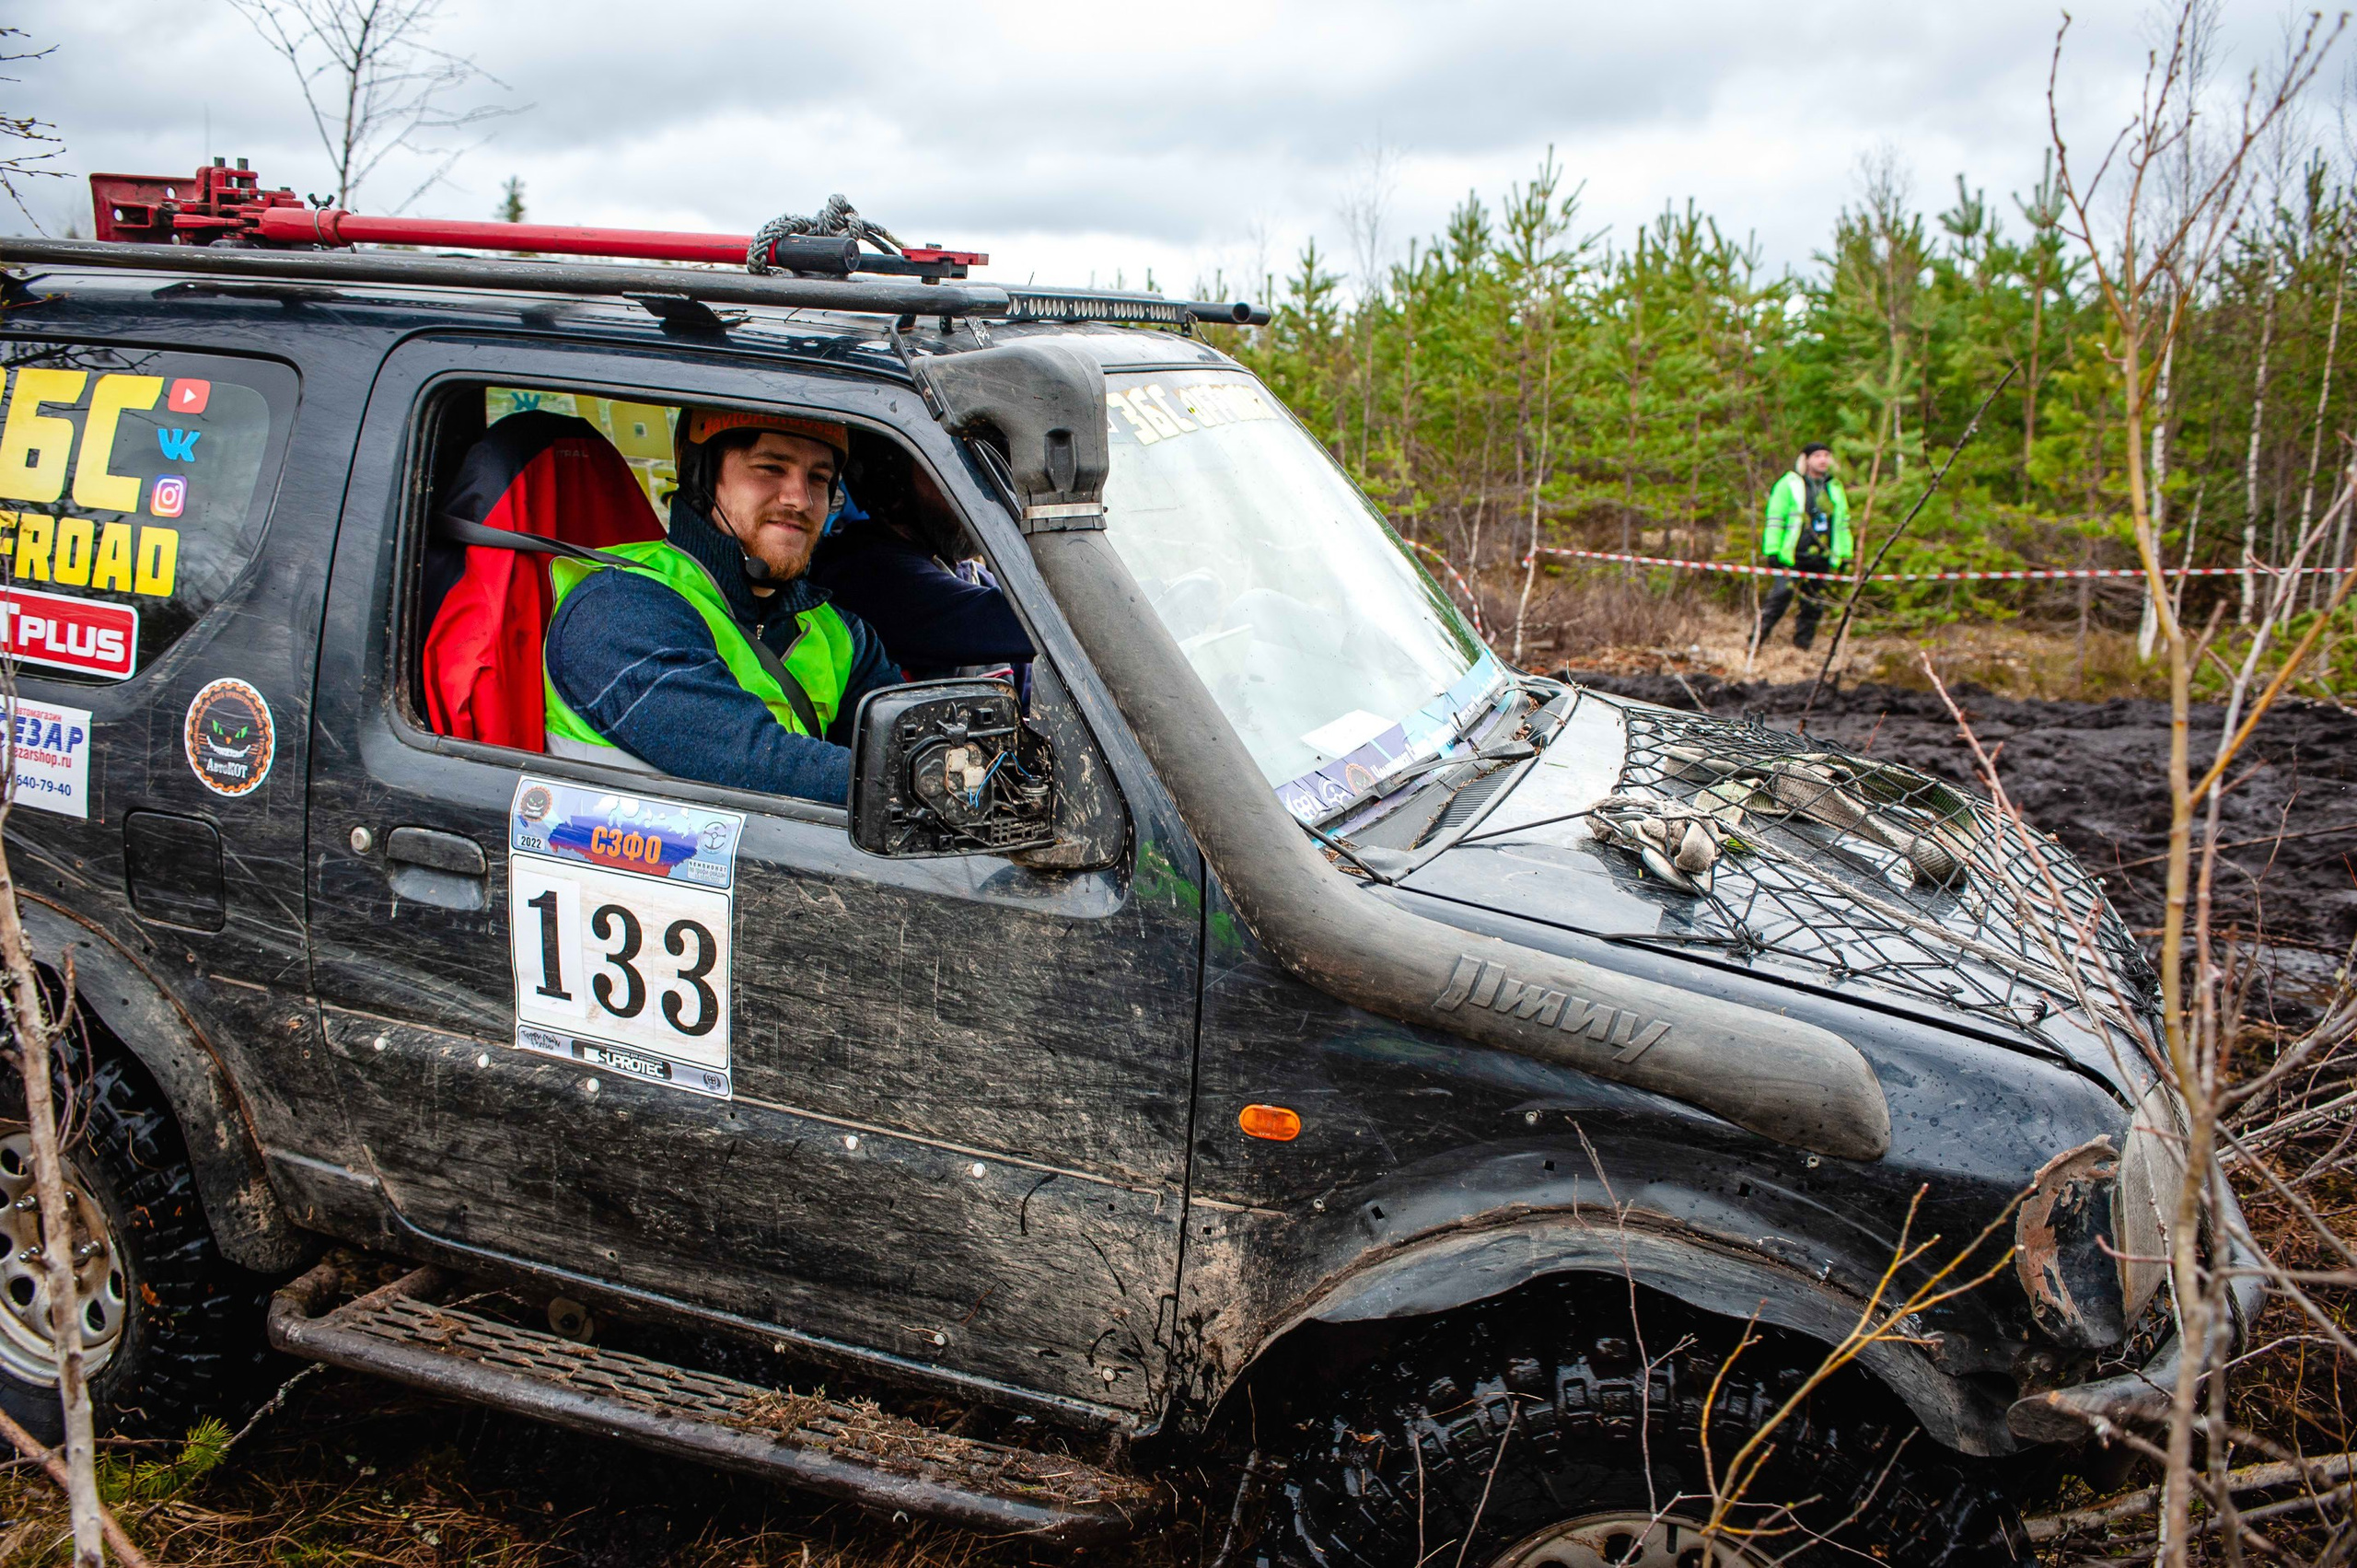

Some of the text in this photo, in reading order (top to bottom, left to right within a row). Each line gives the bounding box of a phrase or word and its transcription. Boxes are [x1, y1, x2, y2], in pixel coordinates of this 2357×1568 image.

[0, 366, 164, 512] БС
[0, 713, 84, 753] ЕЗАР
[7, 745, 72, 768] ezarshop.ru
[521, 835, 543, 849] 2022
[591, 826, 663, 865] СЗФО
[528, 889, 720, 1037] 133
[599, 1051, 664, 1078] SUPROTEC
